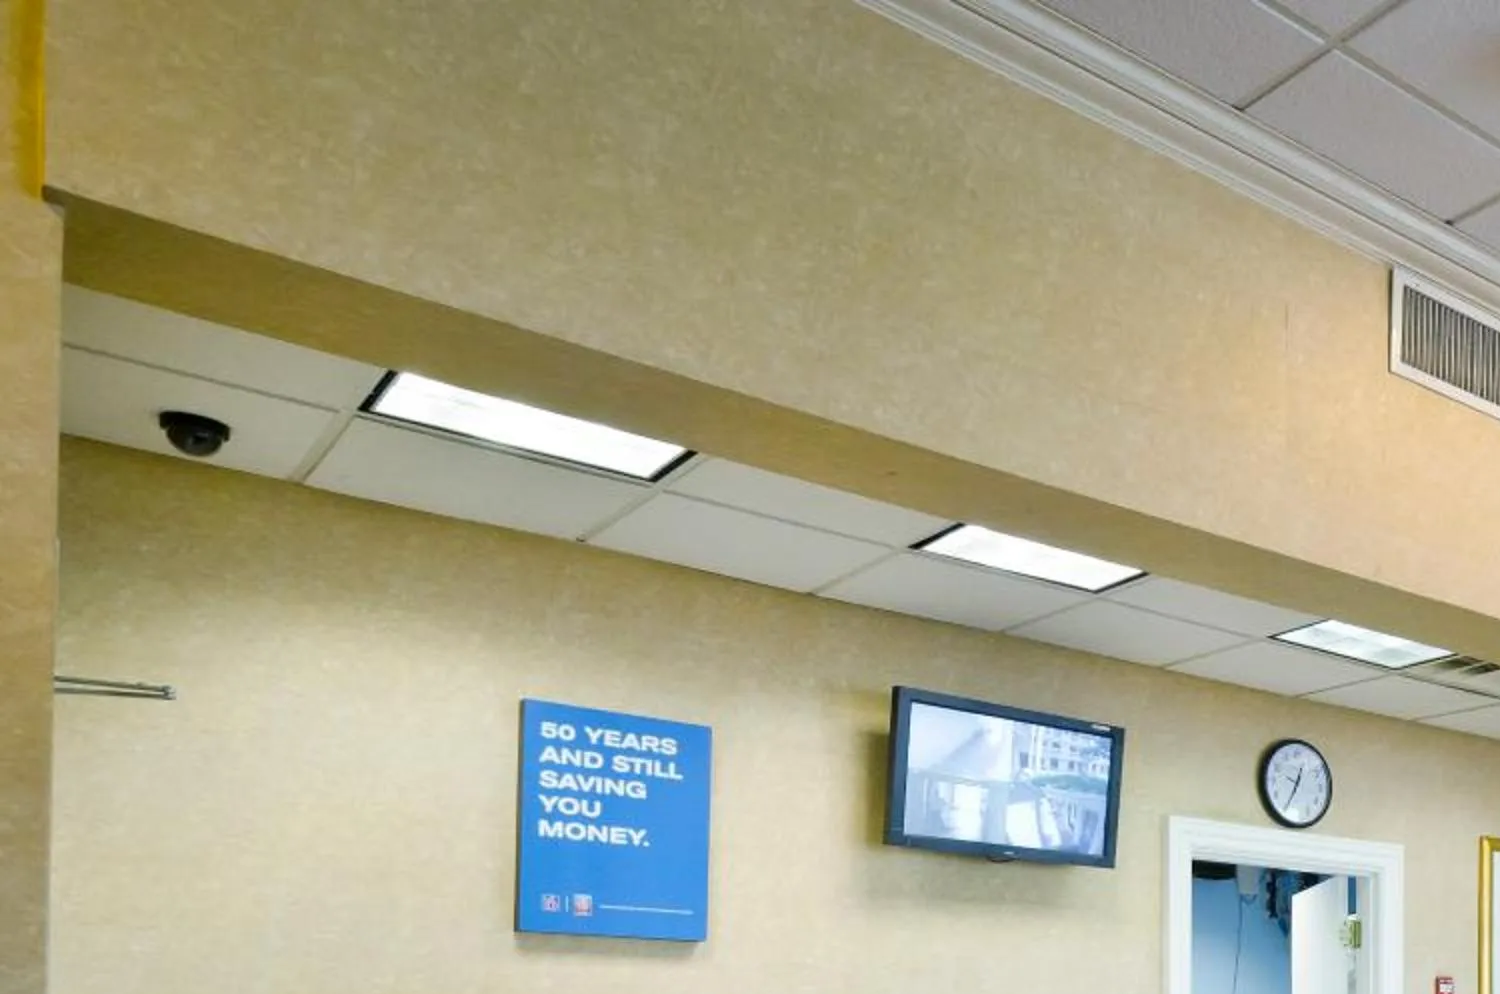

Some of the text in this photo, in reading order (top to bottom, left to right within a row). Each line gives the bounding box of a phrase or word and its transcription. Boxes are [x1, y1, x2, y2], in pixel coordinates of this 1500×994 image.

[540, 721, 678, 755] 50 YEARS
[539, 745, 684, 780] AND STILL
[538, 770, 647, 800] SAVING
[538, 794, 601, 818] YOU
[537, 819, 650, 847] MONEY.
